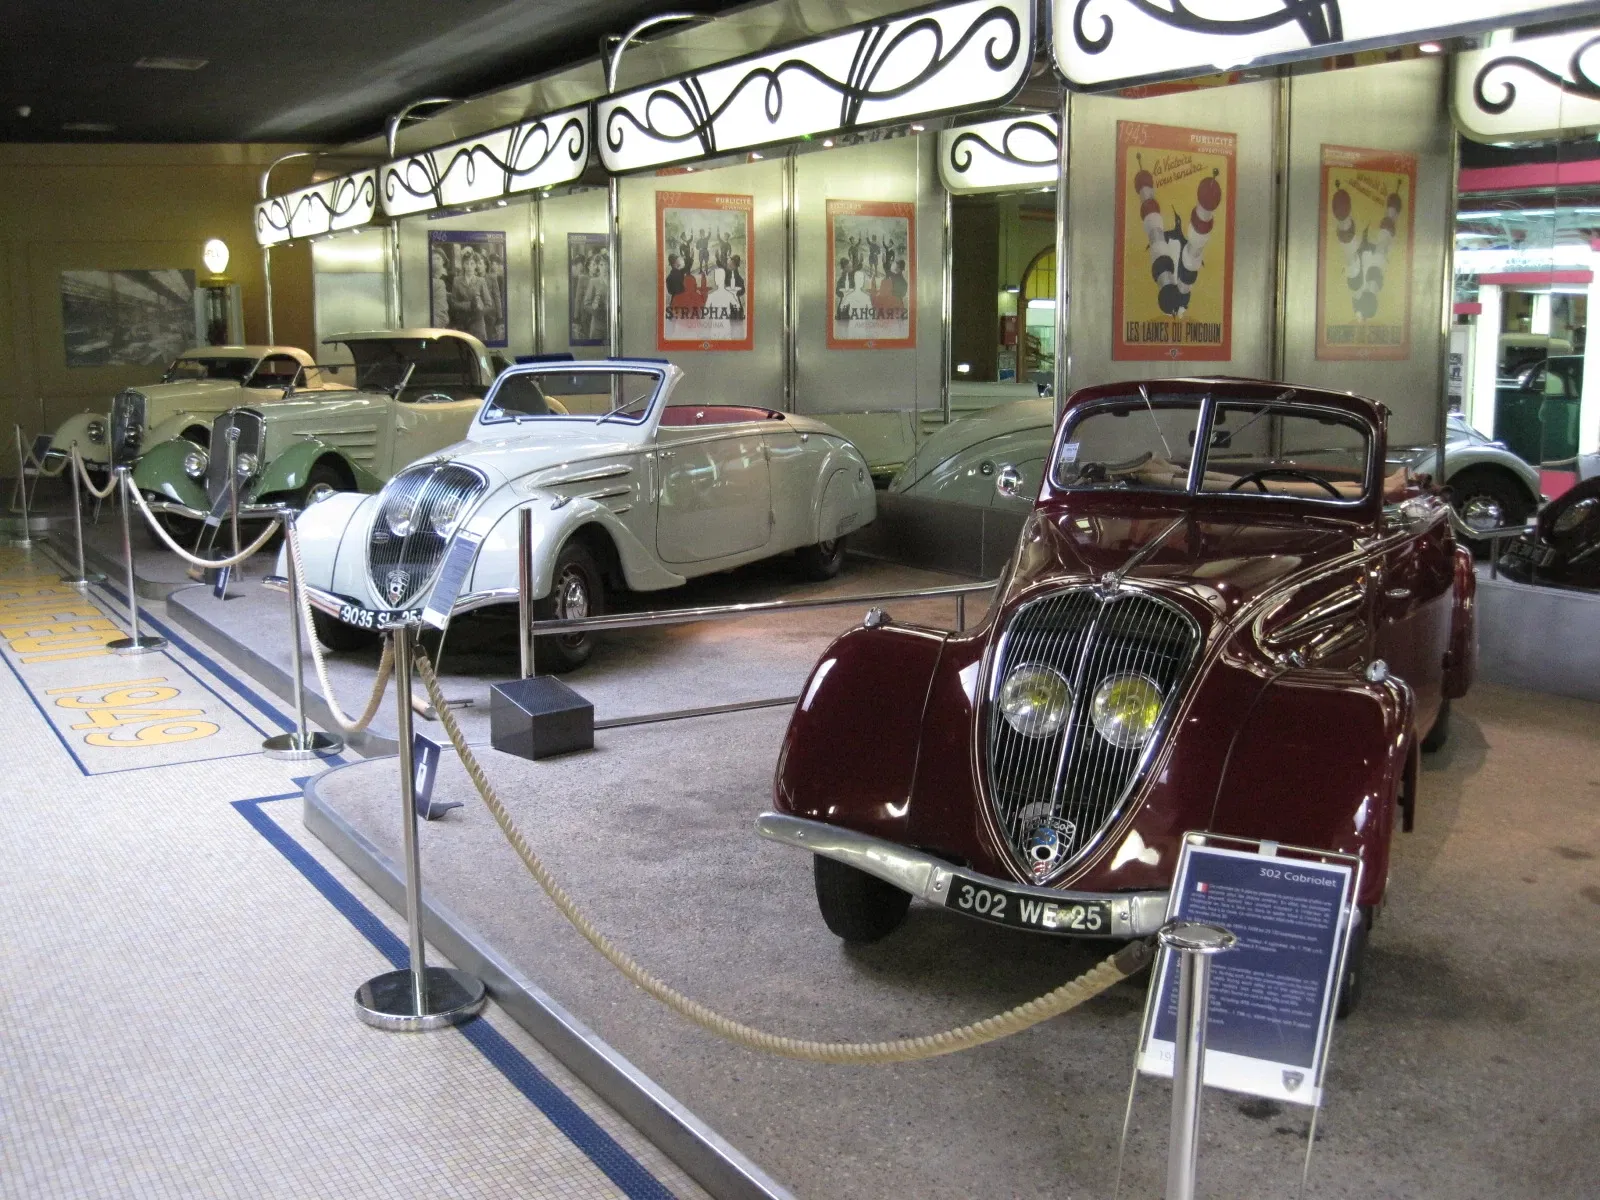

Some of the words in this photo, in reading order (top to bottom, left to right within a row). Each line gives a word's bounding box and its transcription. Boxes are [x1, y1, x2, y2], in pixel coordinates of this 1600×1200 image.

[1118, 120, 1149, 145] 1945
[1126, 321, 1140, 343] LES
[1142, 322, 1169, 343] LAINES
[1171, 322, 1182, 343] DU
[1185, 322, 1221, 344] PINGOUIN
[342, 605, 374, 628] 9035
[44, 677, 221, 747] 1949
[1259, 867, 1282, 880] 302
[1284, 870, 1338, 888] Cabriolet
[958, 884, 1007, 919] 302
[1019, 899, 1061, 928] WE
[1071, 905, 1102, 931] 25
